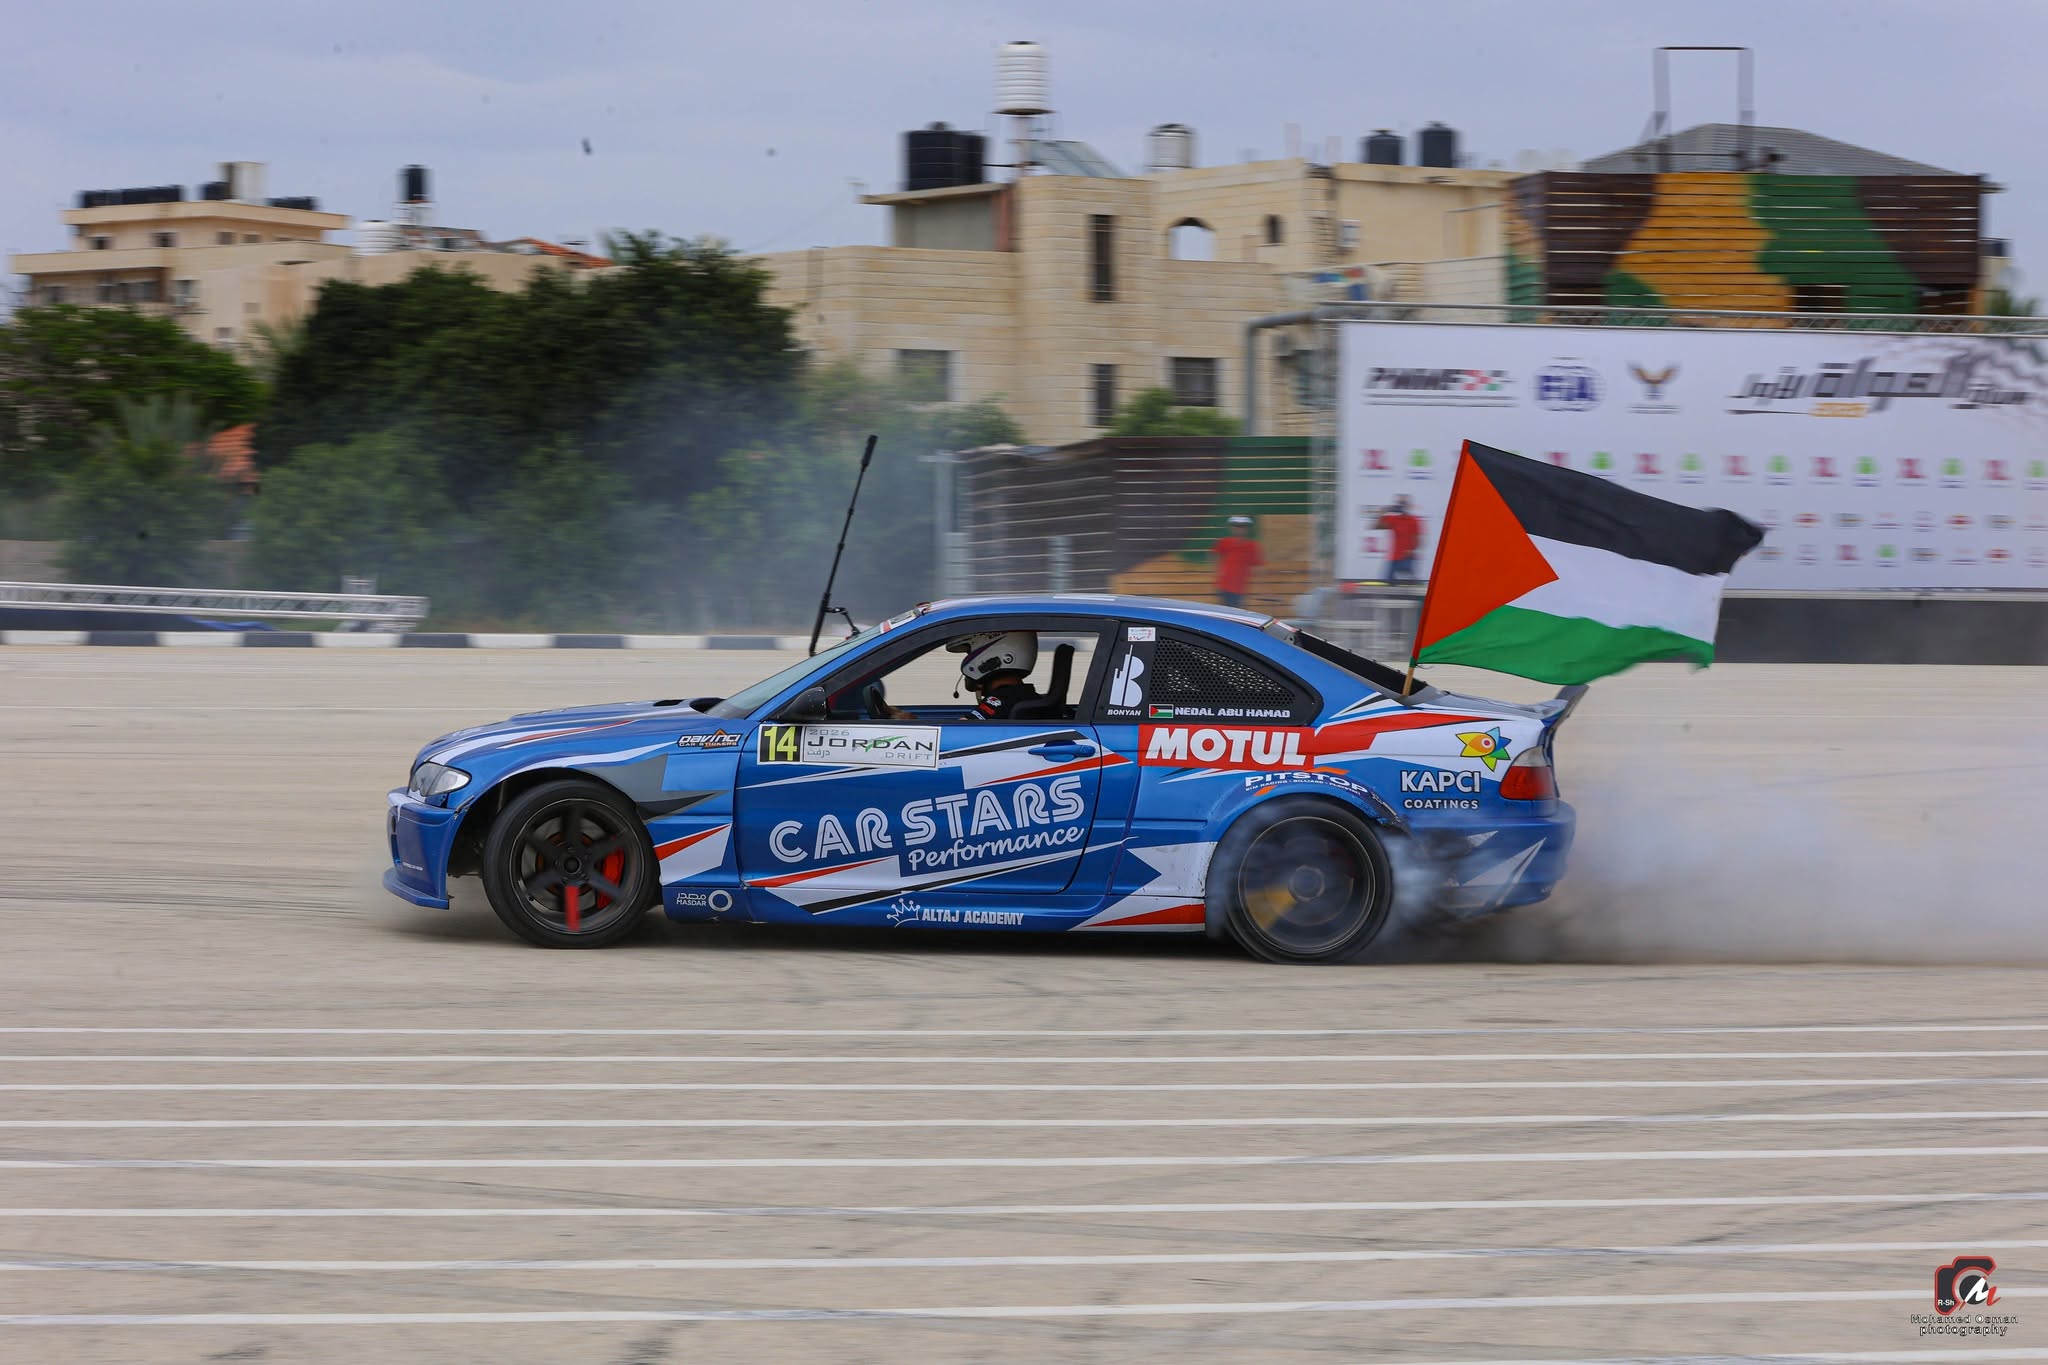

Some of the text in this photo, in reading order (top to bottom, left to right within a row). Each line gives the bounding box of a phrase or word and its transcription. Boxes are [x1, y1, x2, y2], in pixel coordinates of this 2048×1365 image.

[1107, 709, 1141, 717] BONYAN
[1174, 706, 1291, 718] NEDAL ABU HAMAD
[764, 726, 798, 761] 14
[807, 736, 933, 751] JORDAN
[1145, 727, 1307, 766] MOTUL
[884, 752, 933, 760] DRIFT
[1245, 772, 1368, 793] PITSTOP
[1401, 771, 1480, 793] KAPCI
[1404, 799, 1478, 809] COATINGS
[769, 775, 1085, 863] CAR STARS
[908, 825, 1086, 871] Performance
[921, 908, 1025, 925] ALTAJ ACADEMY
